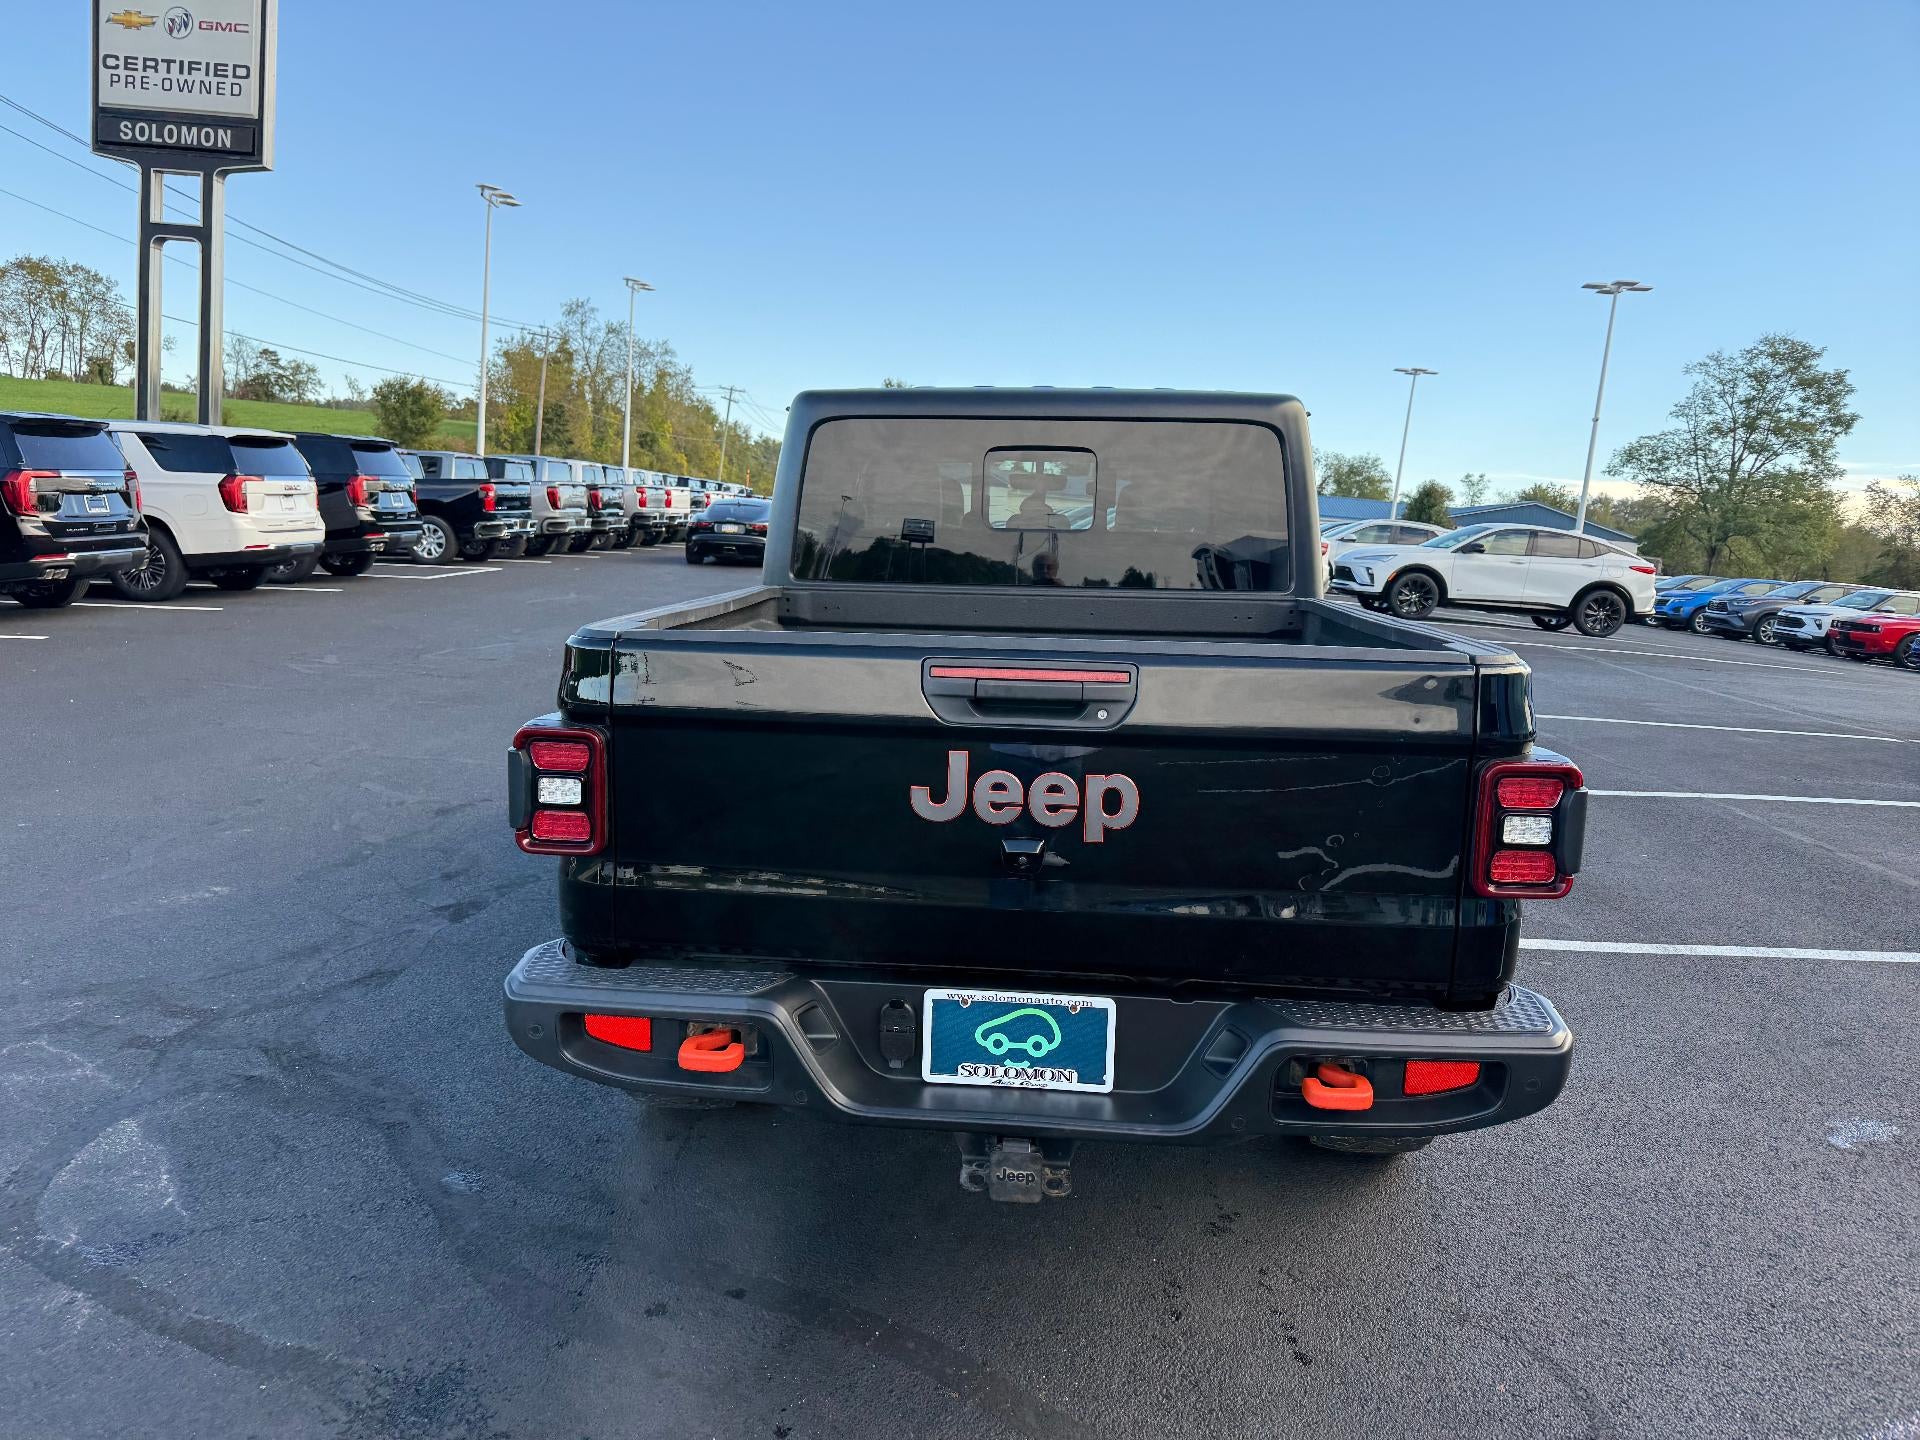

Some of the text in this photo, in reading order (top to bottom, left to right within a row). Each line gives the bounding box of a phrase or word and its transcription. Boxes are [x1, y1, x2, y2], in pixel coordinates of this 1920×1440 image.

[198, 20, 249, 33] GMC
[102, 54, 250, 79] CERTIFIED
[110, 74, 242, 96] PRE-OWNED
[120, 121, 231, 148] SOLOMON
[910, 750, 1139, 842] Jeep
[946, 992, 1093, 1007] www.solomonauto.com
[960, 1064, 1074, 1083] SOLOMON
[996, 1167, 1036, 1185] Jeep
